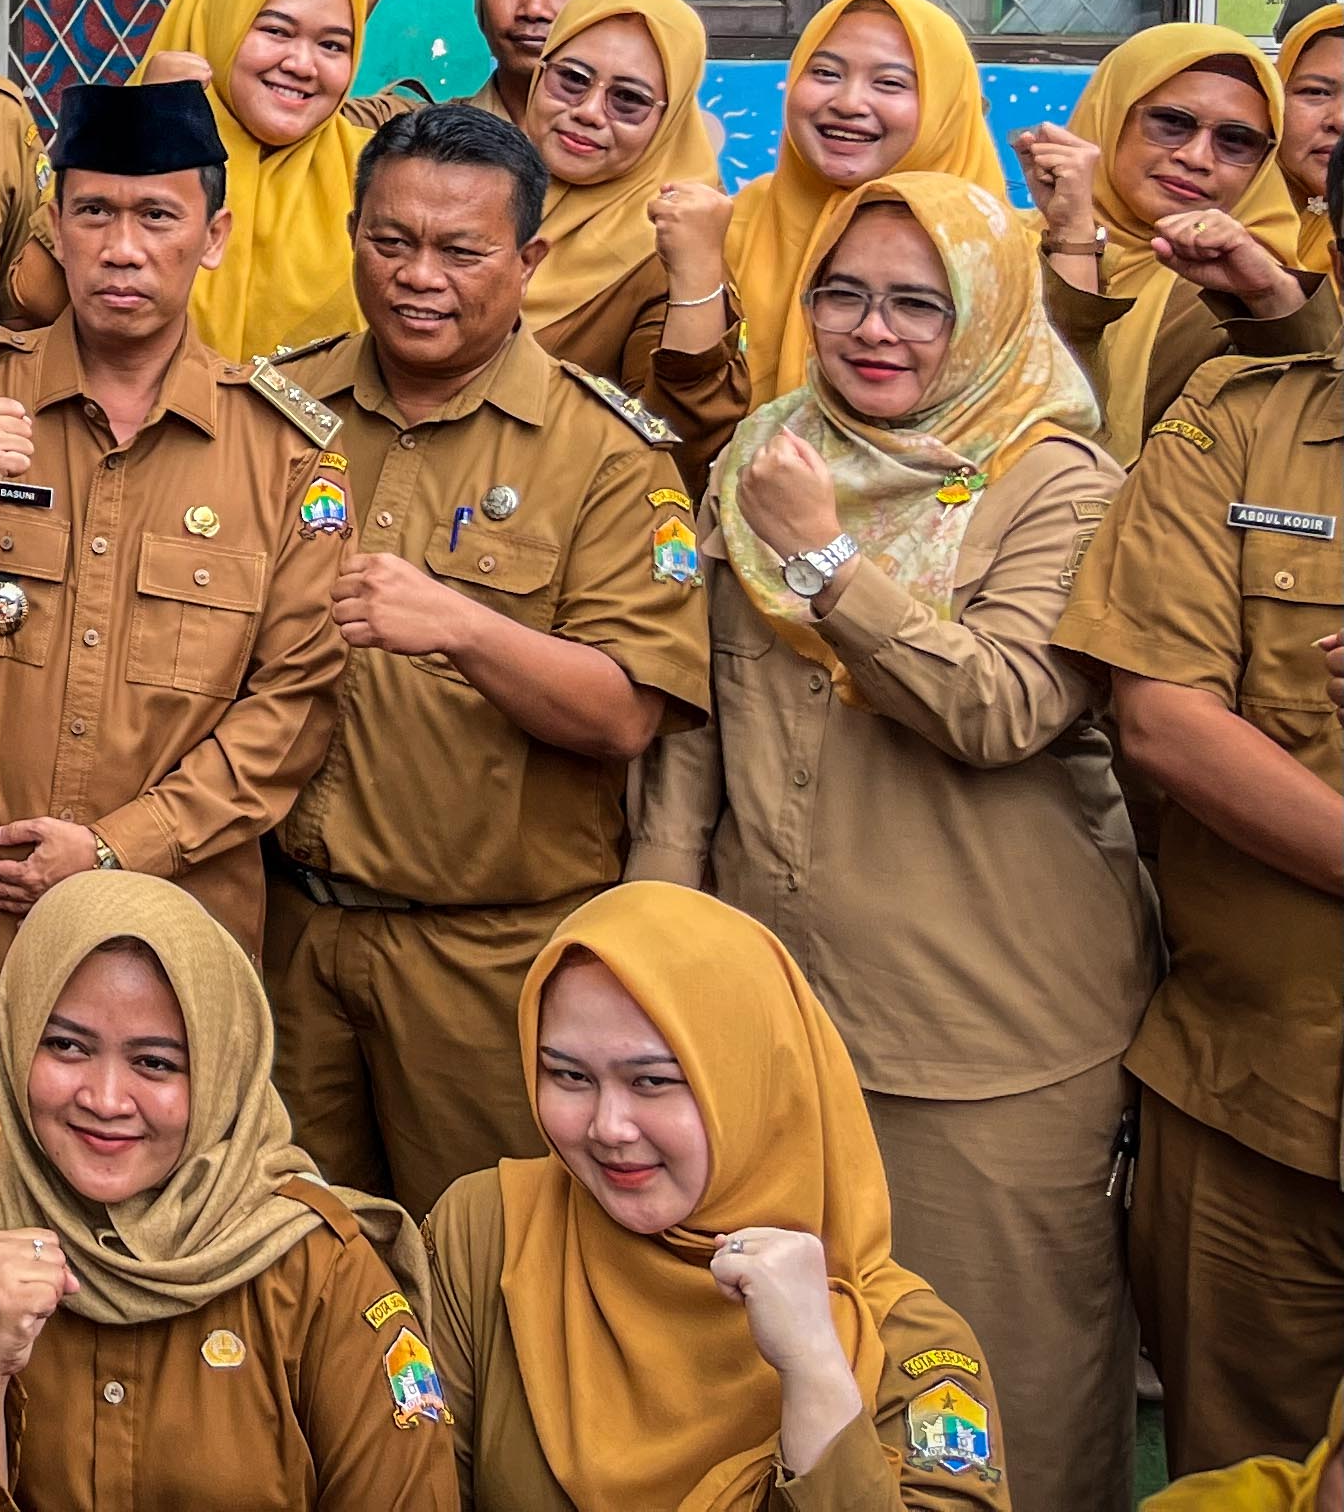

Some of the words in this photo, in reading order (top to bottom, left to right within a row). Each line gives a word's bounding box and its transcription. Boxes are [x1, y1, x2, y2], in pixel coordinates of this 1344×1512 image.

[0, 488, 35, 500] BASUNI
[1238, 509, 1280, 525] ABDUL
[1283, 516, 1323, 530] KODIR
